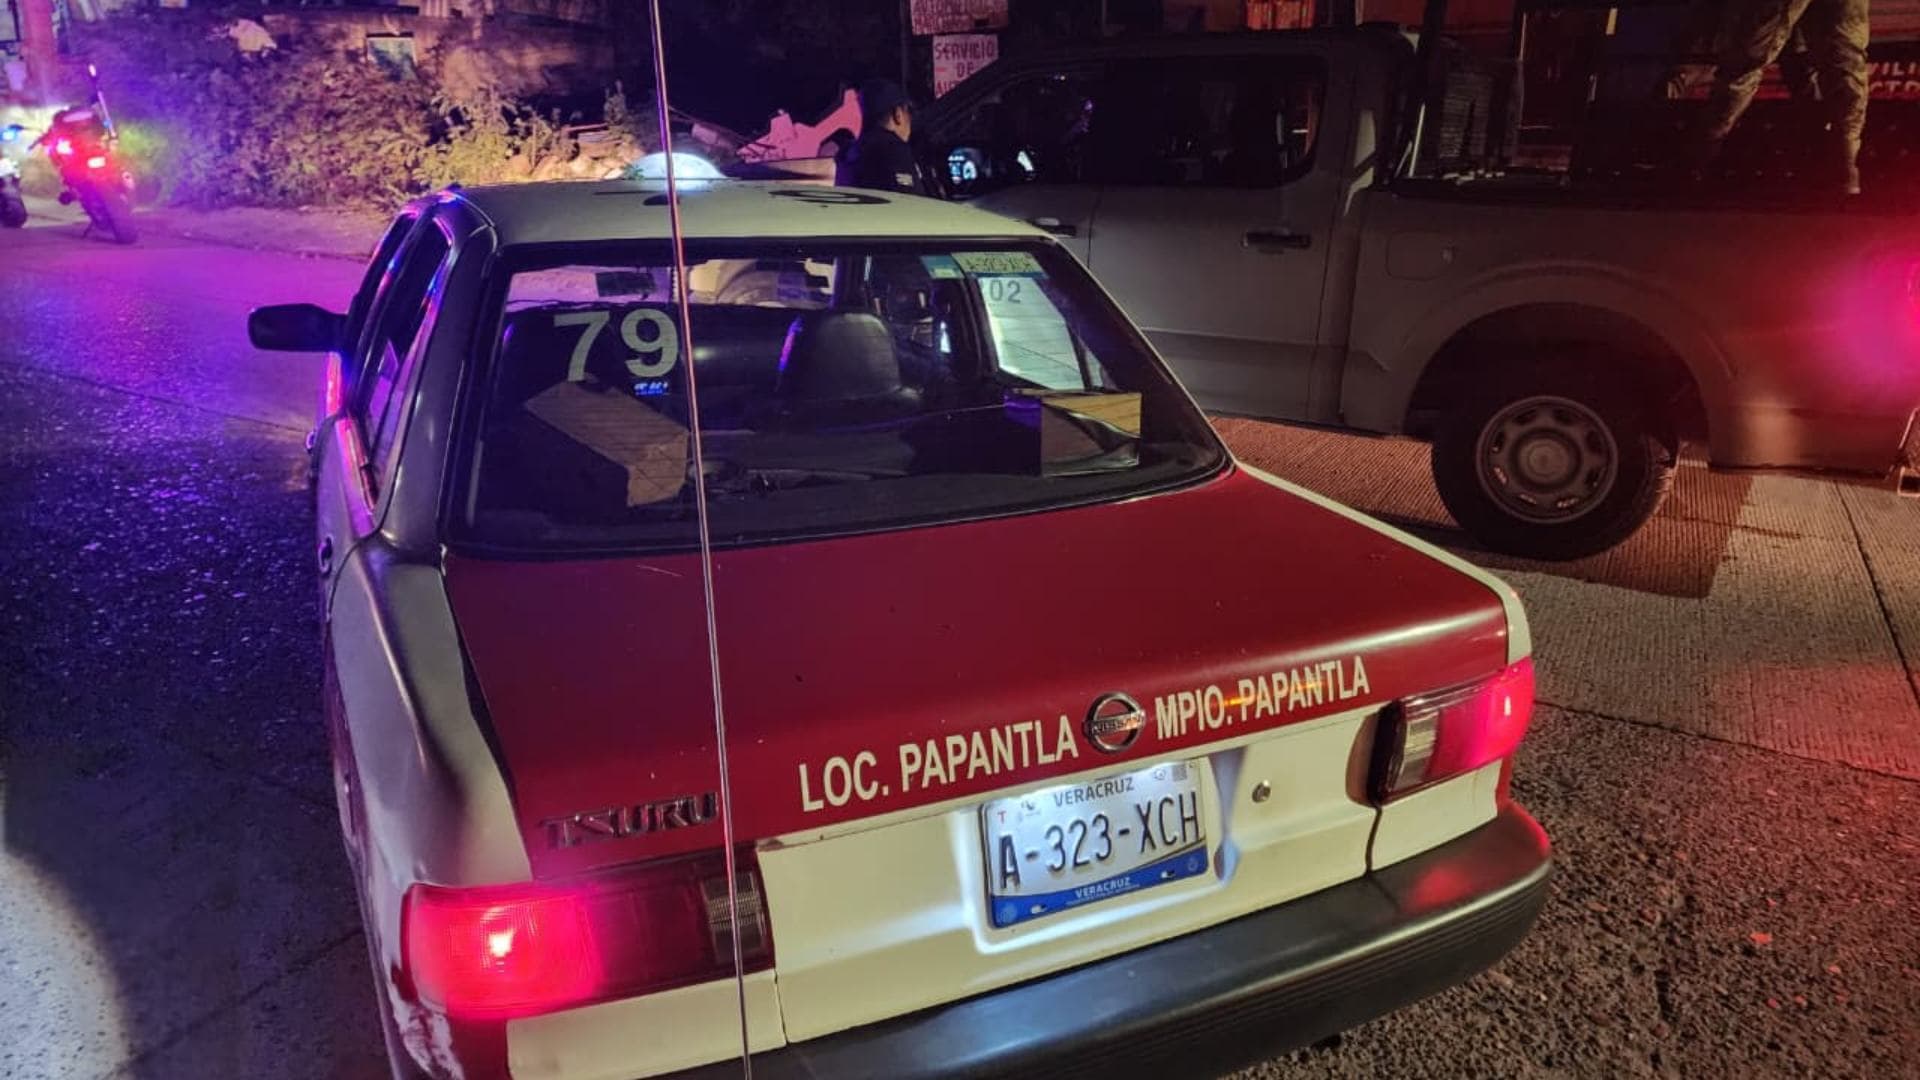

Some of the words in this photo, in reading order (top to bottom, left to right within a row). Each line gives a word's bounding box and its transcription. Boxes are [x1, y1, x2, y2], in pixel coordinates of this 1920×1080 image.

[935, 40, 994, 60] SERVICIO
[990, 279, 1021, 304] 02
[553, 308, 679, 382] 79
[1154, 685, 1233, 740] MPIO.
[1237, 655, 1370, 721] PAPANTLA
[798, 754, 889, 813] LOC.
[899, 715, 1079, 792] PAPANTLA
[1053, 776, 1135, 808] VERACRUZ
[540, 791, 719, 848] TSURU
[1000, 791, 1200, 889] A-323-XCH
[1075, 876, 1131, 899] VERACRUZ
